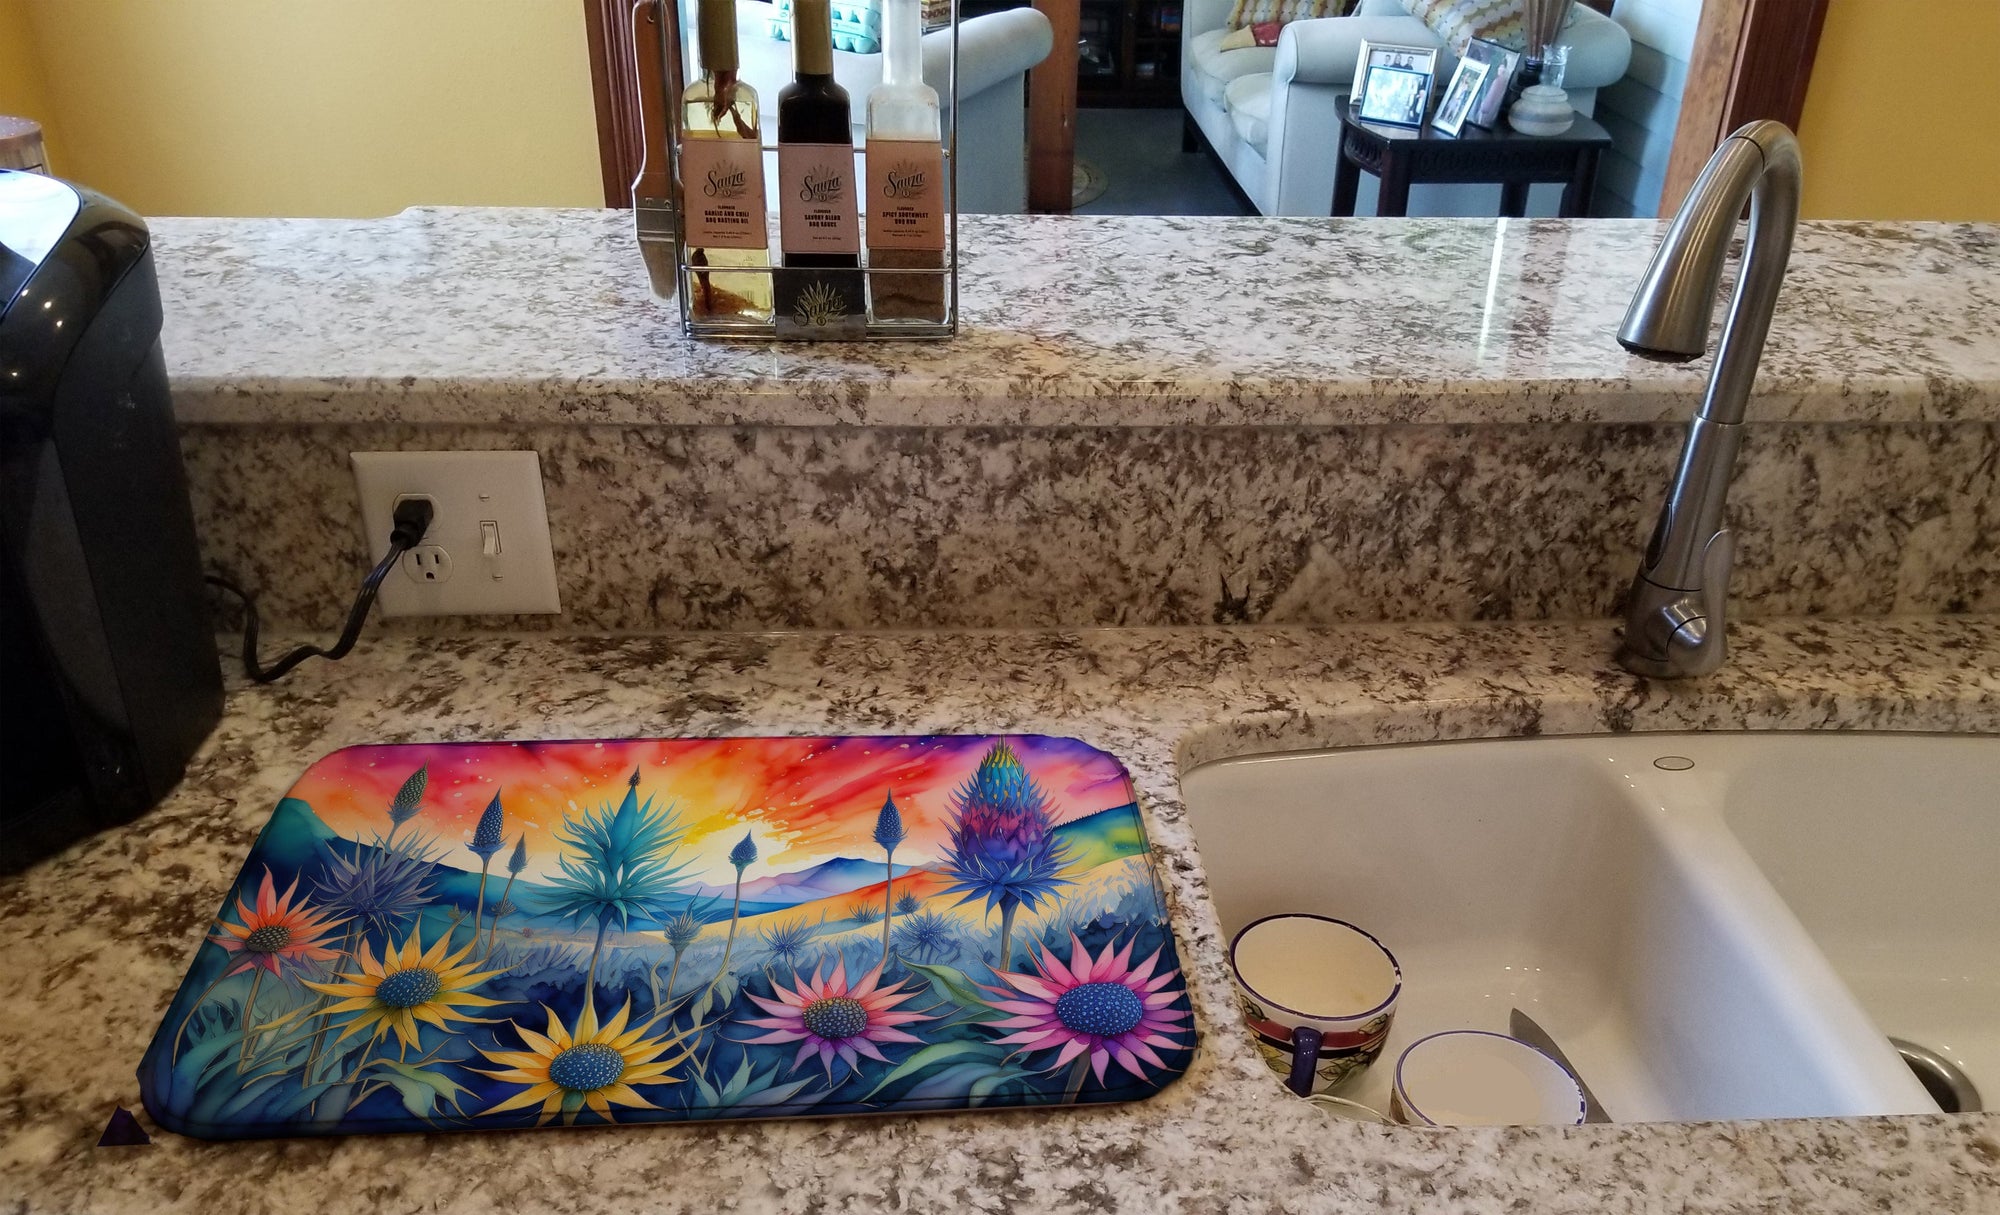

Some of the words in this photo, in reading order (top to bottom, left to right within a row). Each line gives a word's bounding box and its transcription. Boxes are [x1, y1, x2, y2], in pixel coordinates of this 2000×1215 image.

[704, 170, 745, 197] Sauza
[800, 175, 842, 202] Sauza
[884, 171, 924, 198] Sauza
